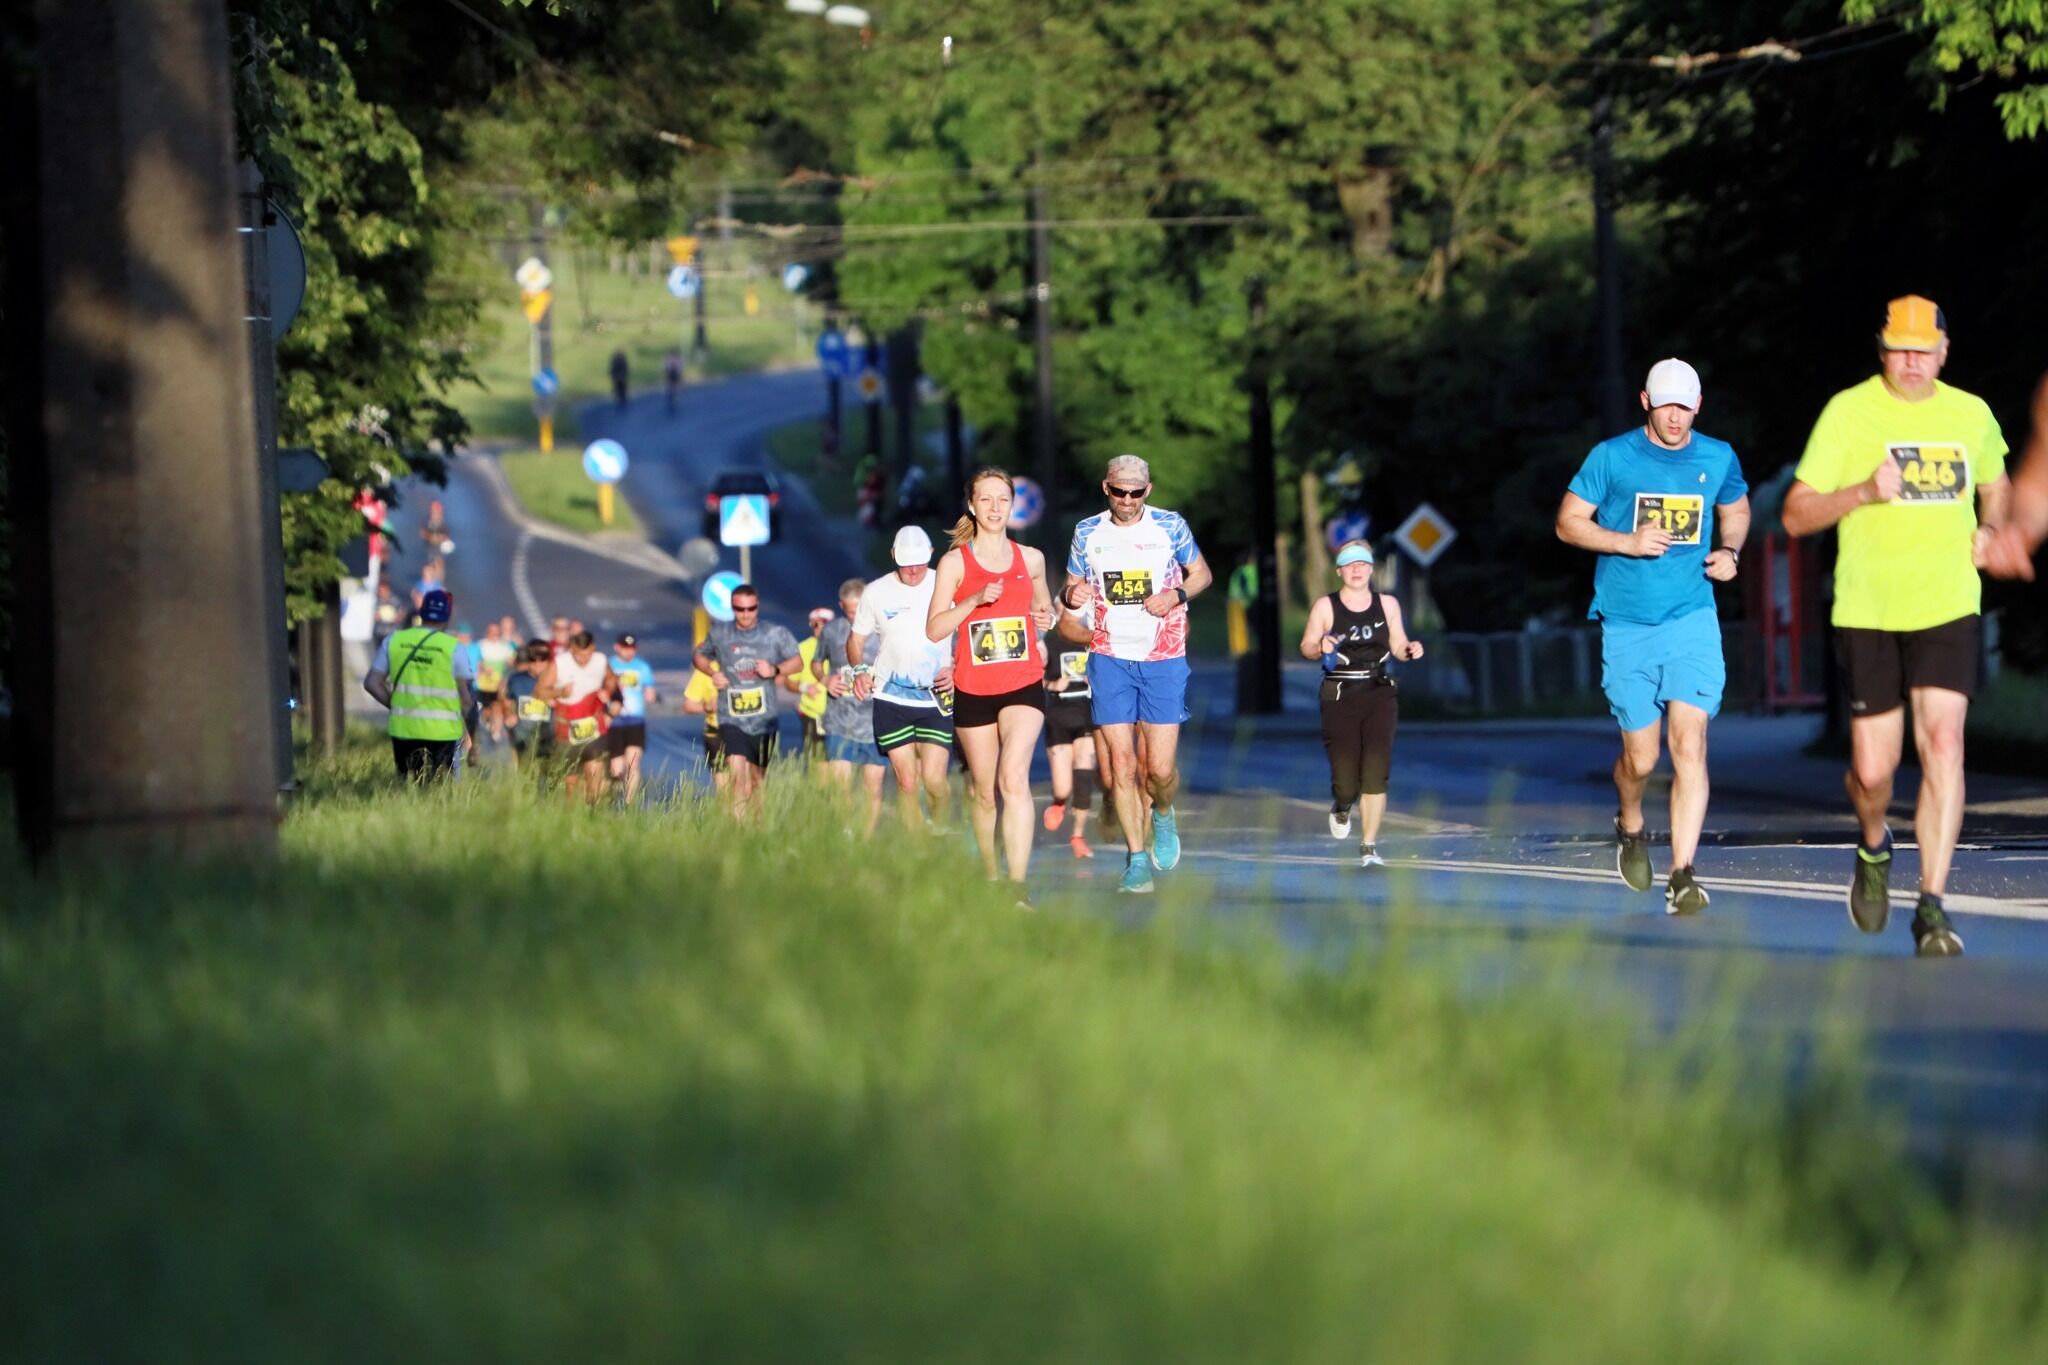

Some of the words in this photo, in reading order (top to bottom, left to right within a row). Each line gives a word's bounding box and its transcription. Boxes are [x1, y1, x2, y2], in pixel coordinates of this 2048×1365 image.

[1903, 460, 1956, 487] 446
[1112, 580, 1145, 596] 454
[1349, 625, 1373, 641] 20
